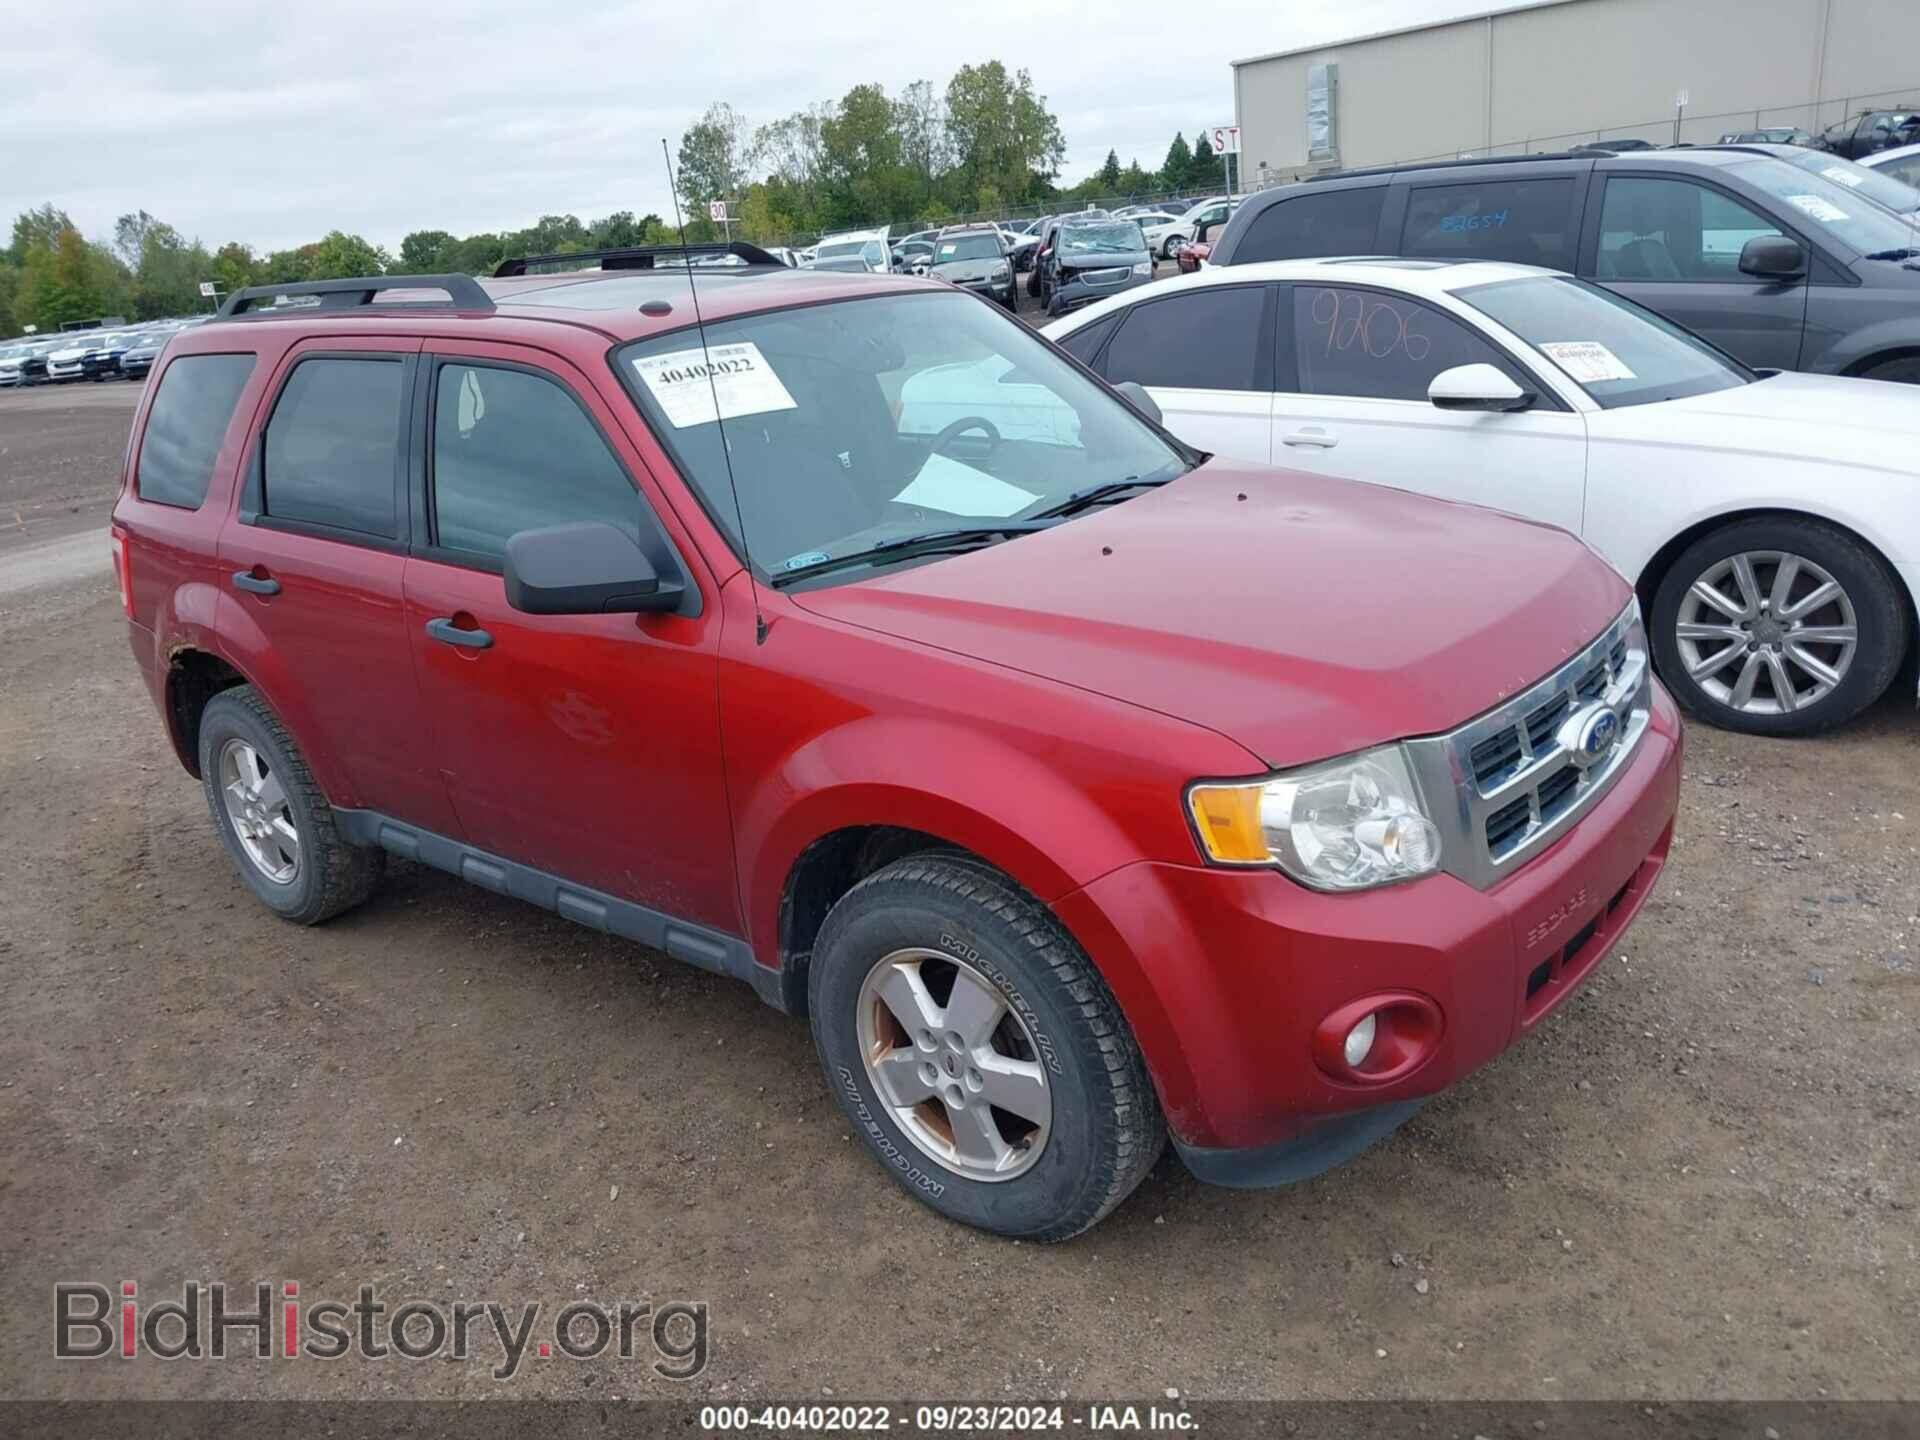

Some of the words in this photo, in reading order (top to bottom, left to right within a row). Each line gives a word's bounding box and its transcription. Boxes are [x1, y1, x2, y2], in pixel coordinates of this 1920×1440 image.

[711, 203, 725, 218] 30
[1312, 288, 1431, 361] 9206
[658, 358, 755, 384] 40402022
[940, 933, 1062, 1076] MICHELIN
[838, 1066, 945, 1199] MICHELIN
